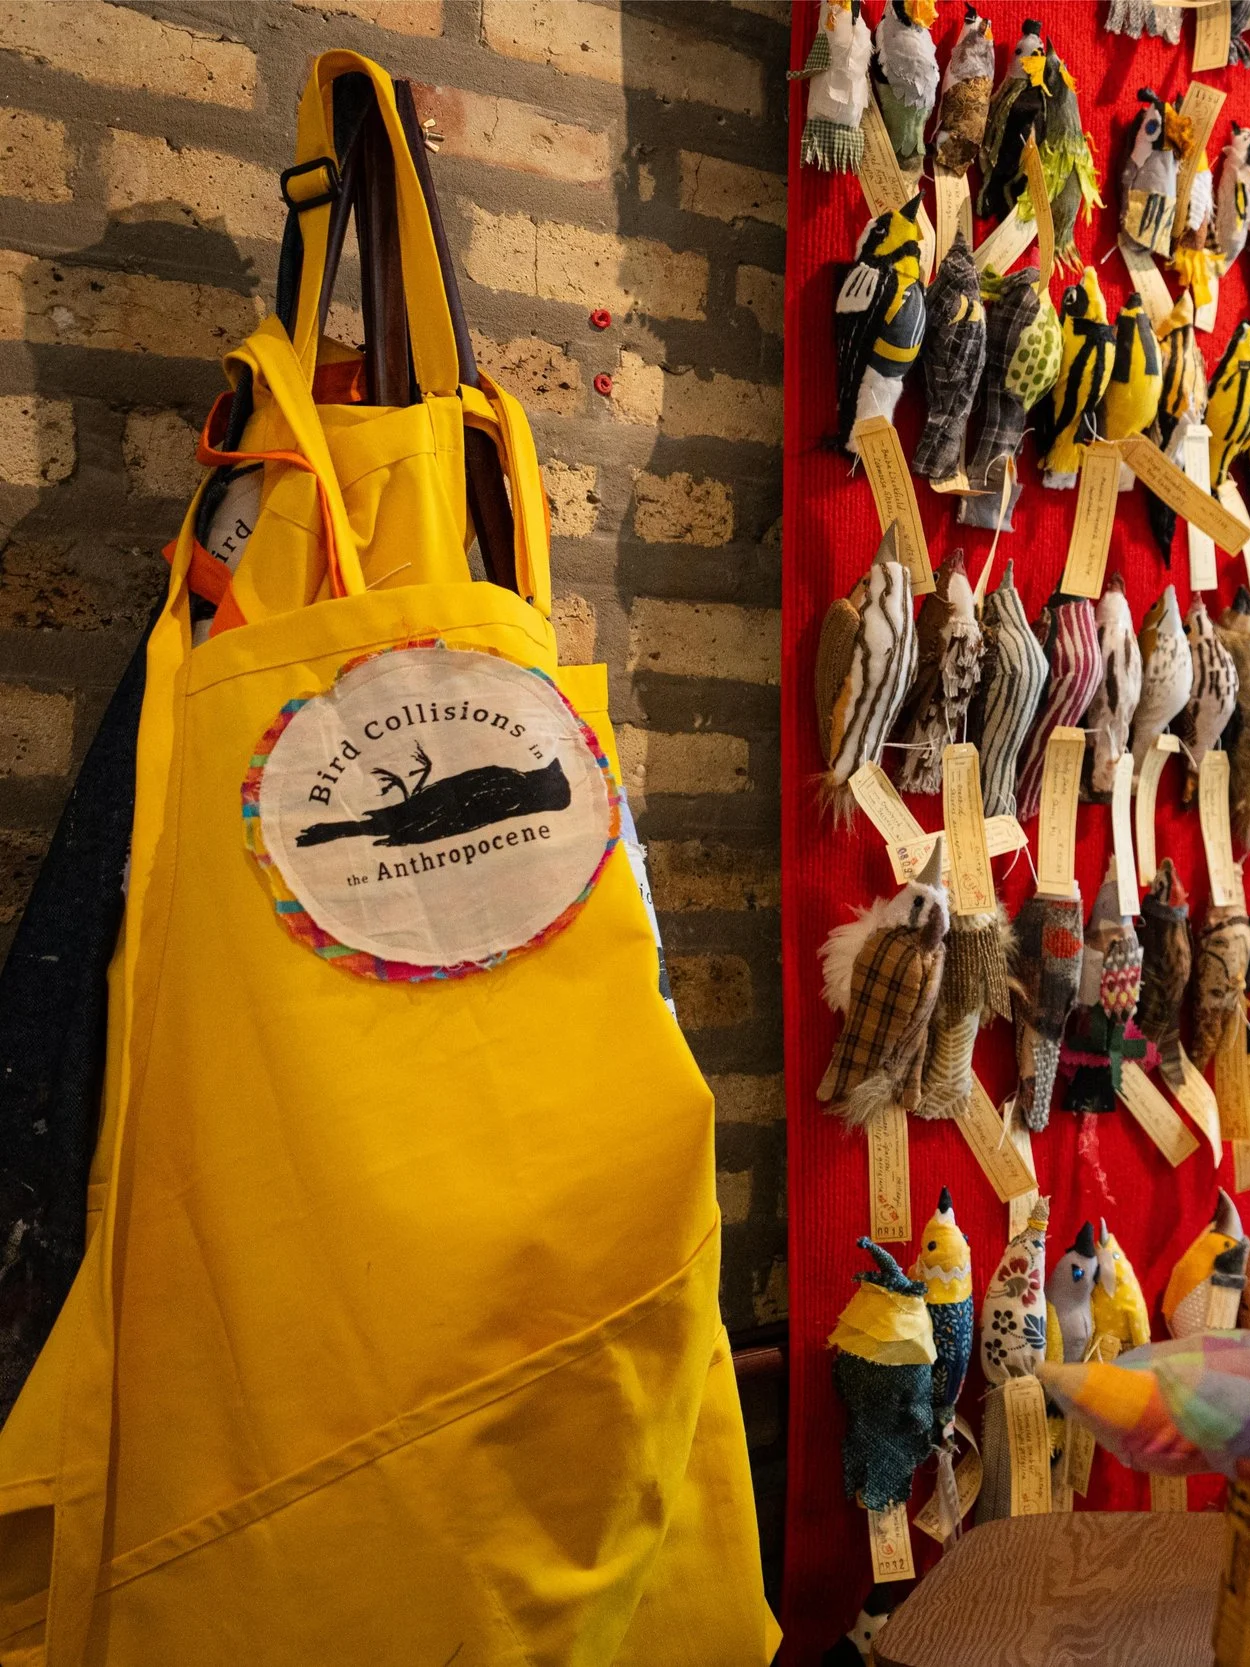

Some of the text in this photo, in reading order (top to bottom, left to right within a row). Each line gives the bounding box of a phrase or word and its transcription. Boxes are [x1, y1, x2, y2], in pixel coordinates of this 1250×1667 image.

[212, 518, 252, 564] ird
[309, 701, 544, 806] Bird Collisions in
[347, 824, 551, 886] the Anthropocene
